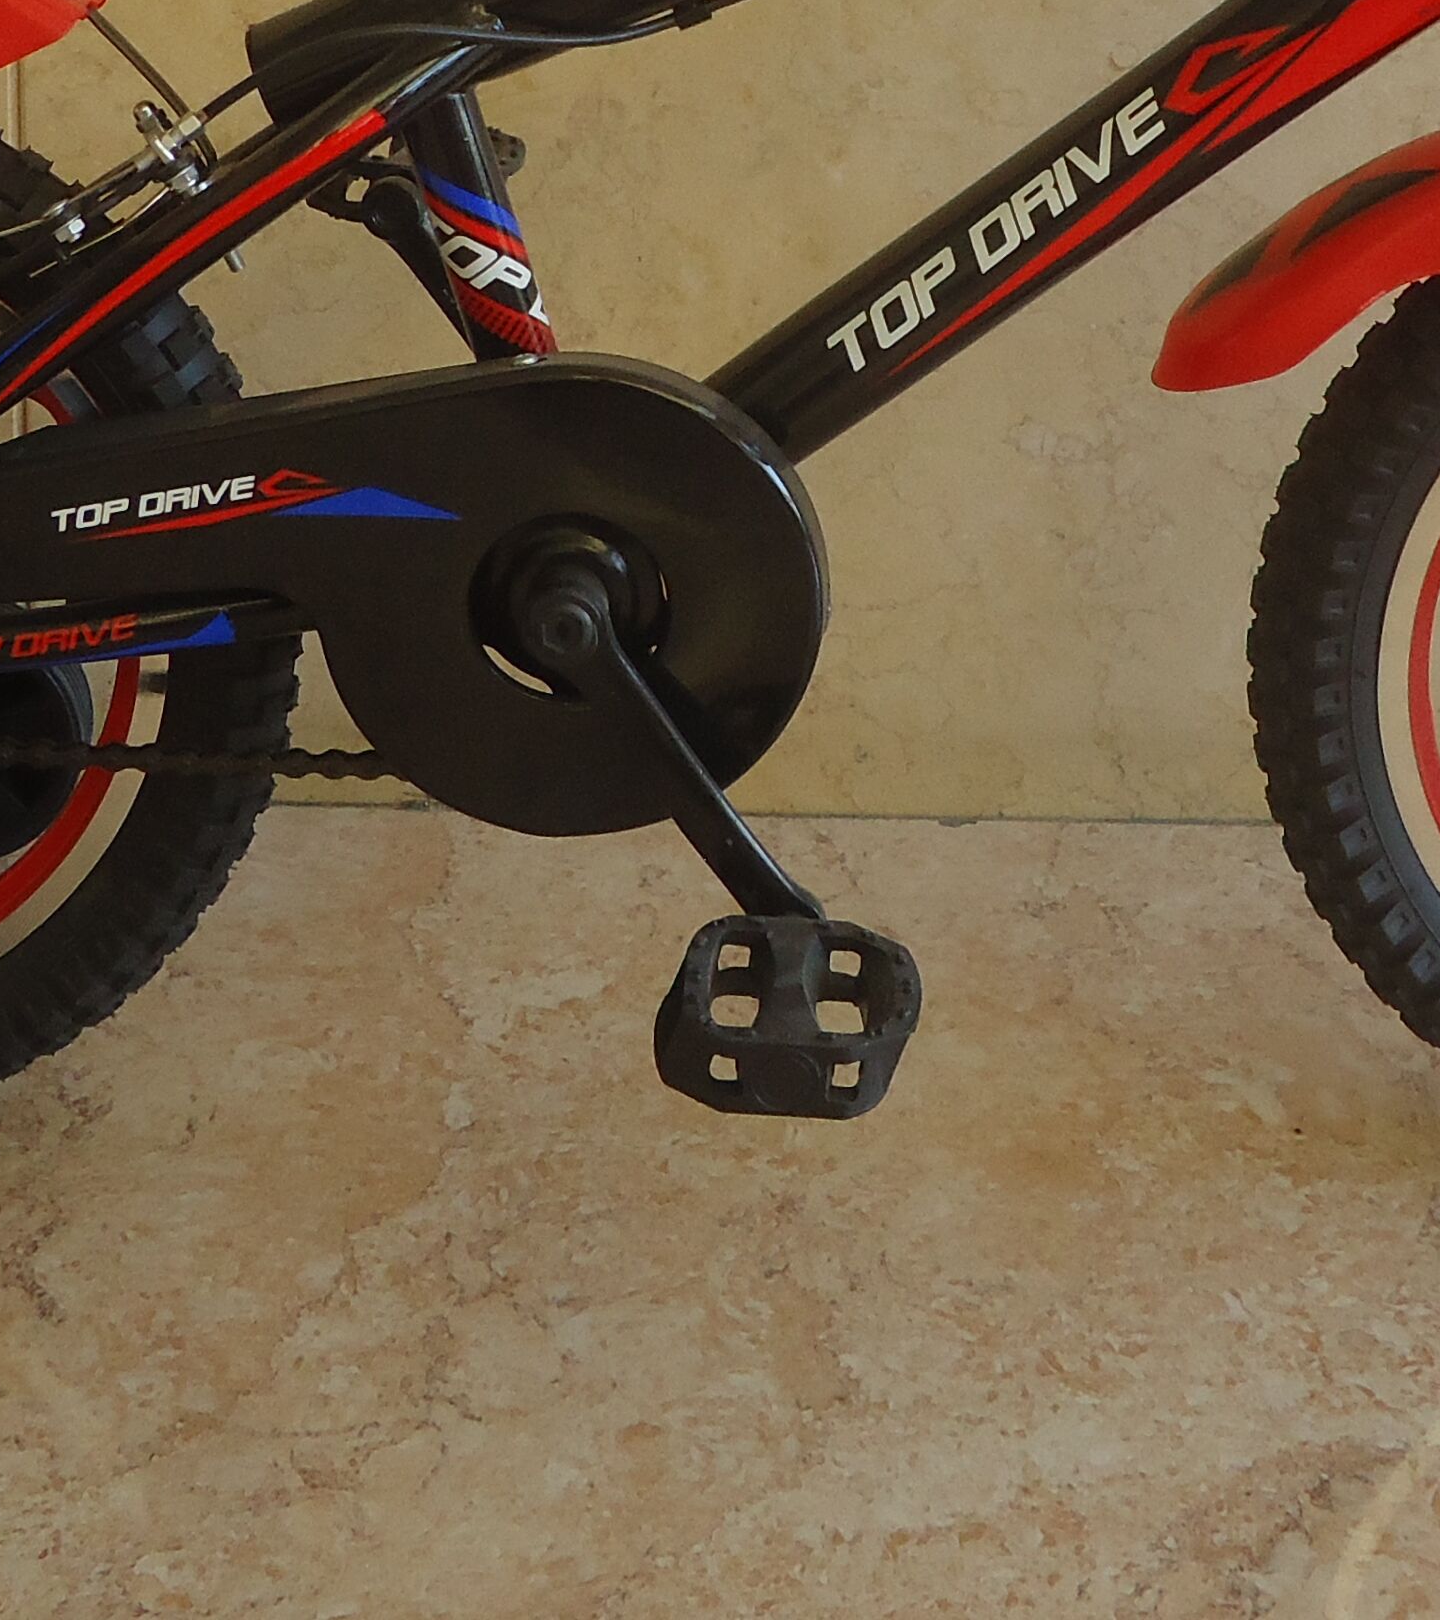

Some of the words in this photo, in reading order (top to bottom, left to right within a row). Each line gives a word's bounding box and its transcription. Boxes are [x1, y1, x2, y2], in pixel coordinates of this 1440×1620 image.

[826, 246, 957, 373] TOP
[968, 86, 1166, 274] DRIVE
[51, 497, 129, 533] TOP
[138, 475, 256, 518] DRIVE
[10, 613, 140, 659] DRIVE
